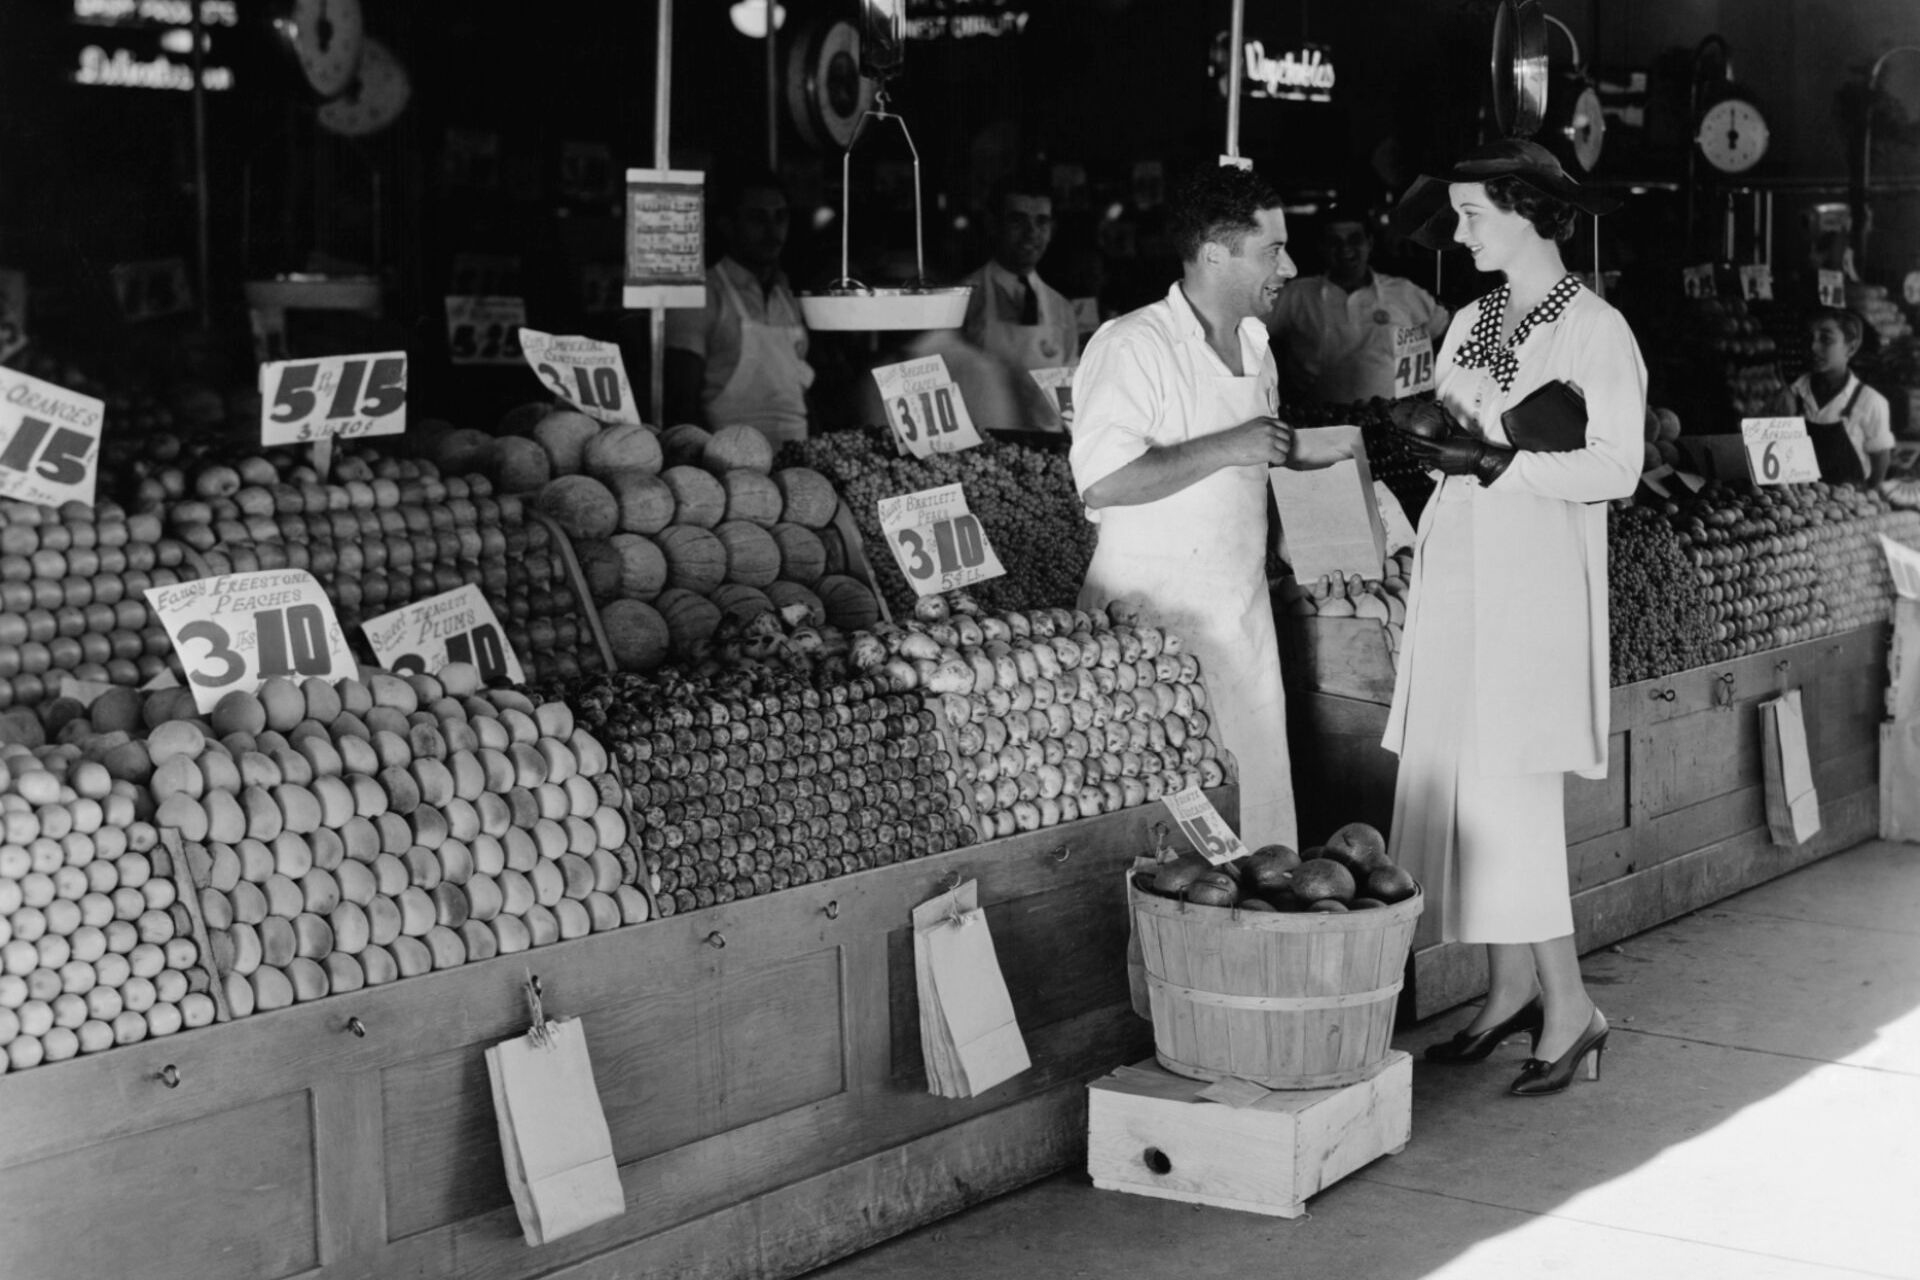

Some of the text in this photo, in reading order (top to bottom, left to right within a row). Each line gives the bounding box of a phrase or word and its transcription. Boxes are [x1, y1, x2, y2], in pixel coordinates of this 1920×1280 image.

[270, 363, 320, 424] 5
[325, 357, 406, 418] 15
[572, 365, 622, 412] 10
[1395, 350, 1432, 388] 4 15
[6, 384, 99, 428] ORANGES
[897, 397, 918, 442] 3
[918, 387, 960, 437] 10
[0, 415, 95, 486] 15
[297, 423, 313, 440] 3
[1762, 440, 1780, 480] 6
[906, 490, 957, 512] BARTLETT
[898, 528, 935, 580] 3
[933, 515, 985, 574] 10
[156, 572, 312, 613] Fancy FREESTONE
[210, 588, 302, 616] PEACHES
[176, 619, 247, 688] 3
[254, 603, 332, 680] 10
[416, 608, 477, 646] PLUMS
[445, 622, 508, 682] 10
[1181, 815, 1226, 858] 15
